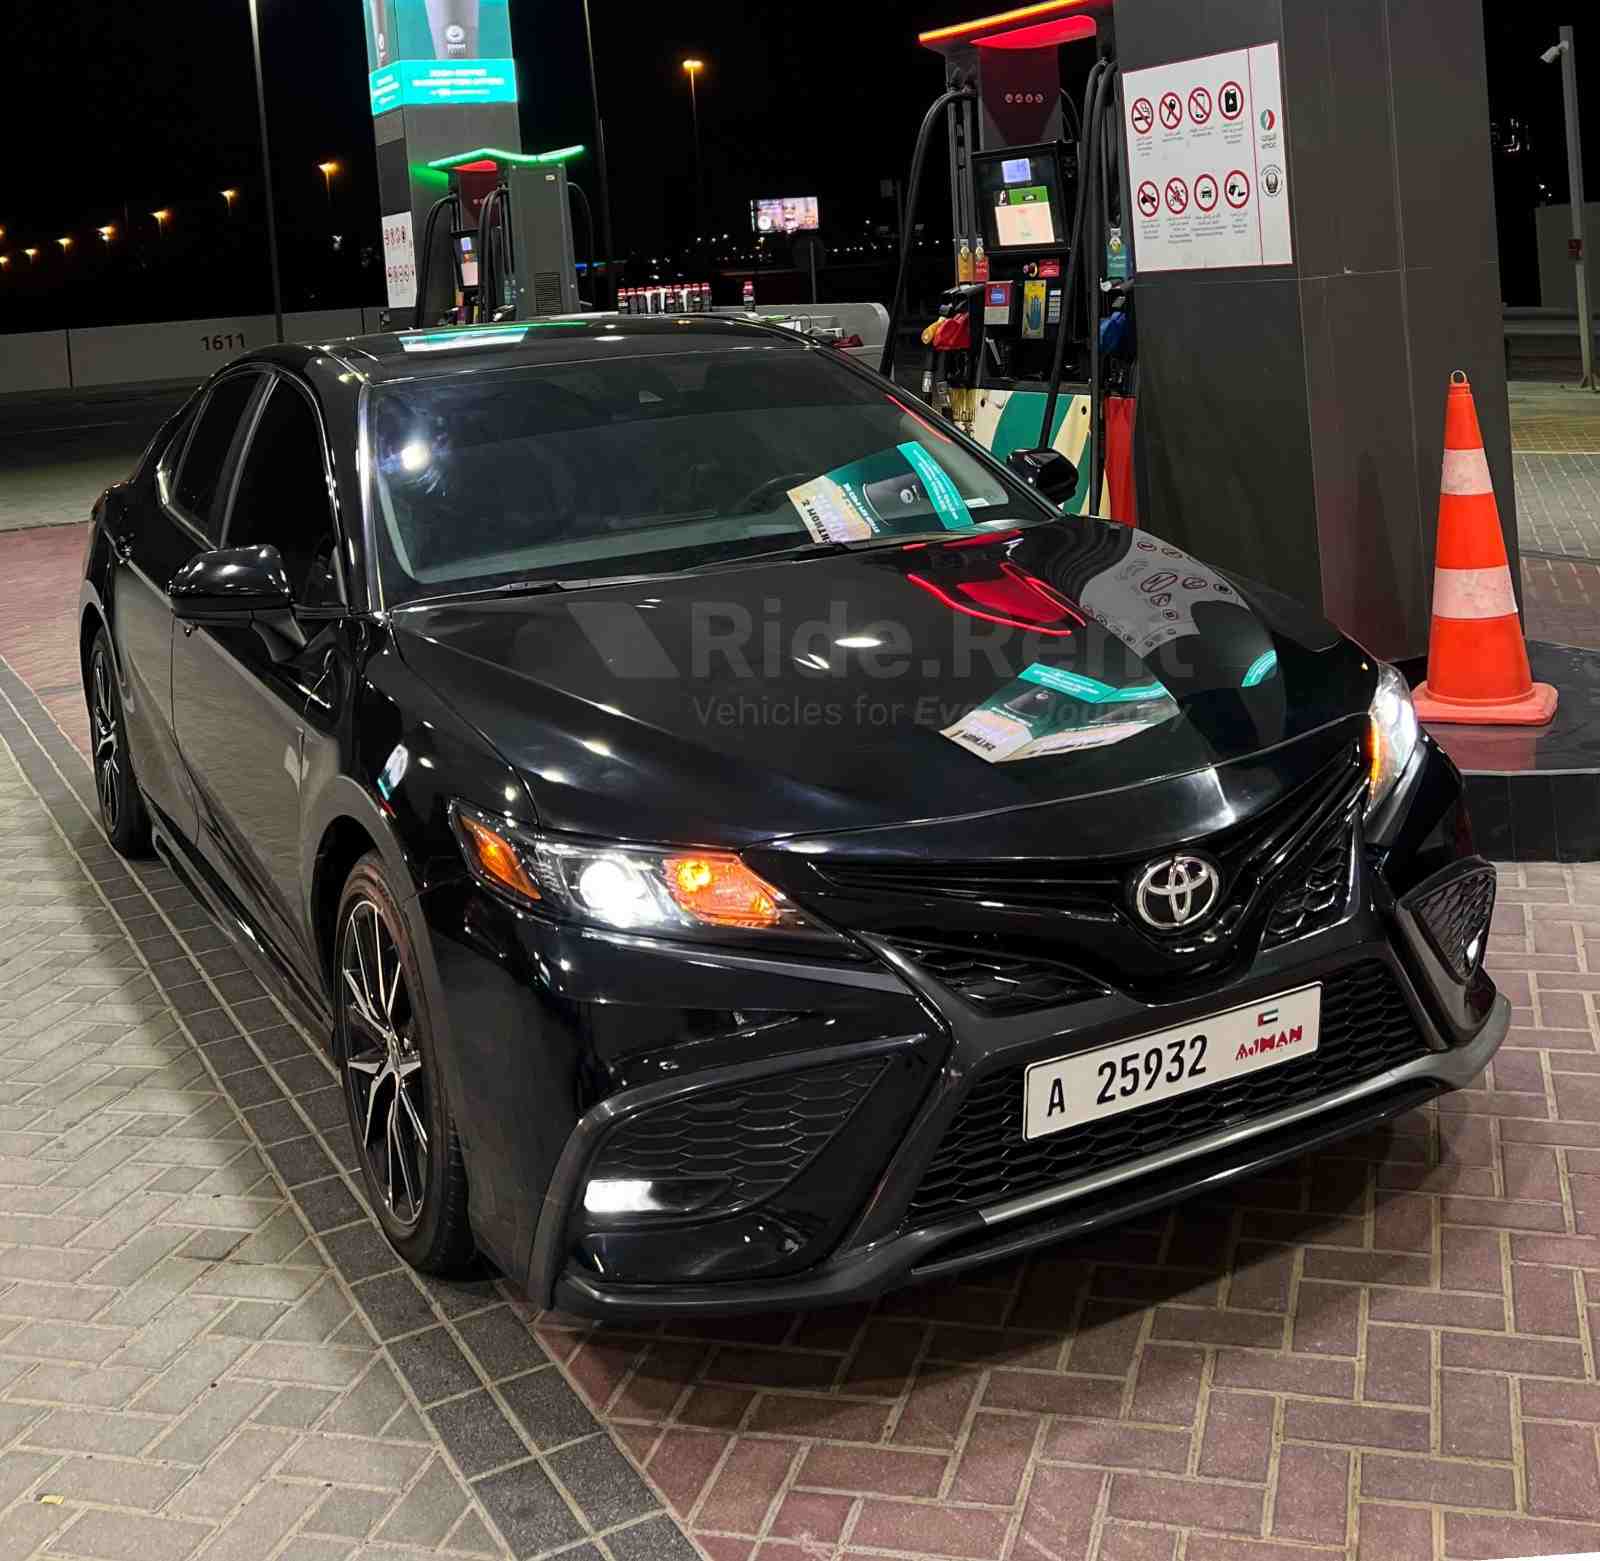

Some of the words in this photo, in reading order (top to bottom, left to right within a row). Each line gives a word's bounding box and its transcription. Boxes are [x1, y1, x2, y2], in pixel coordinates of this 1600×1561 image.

[200, 333, 246, 351] 1611
[1047, 1078, 1066, 1117] A
[1096, 1034, 1209, 1105] 25932
[1235, 1024, 1303, 1061] AJMAN
